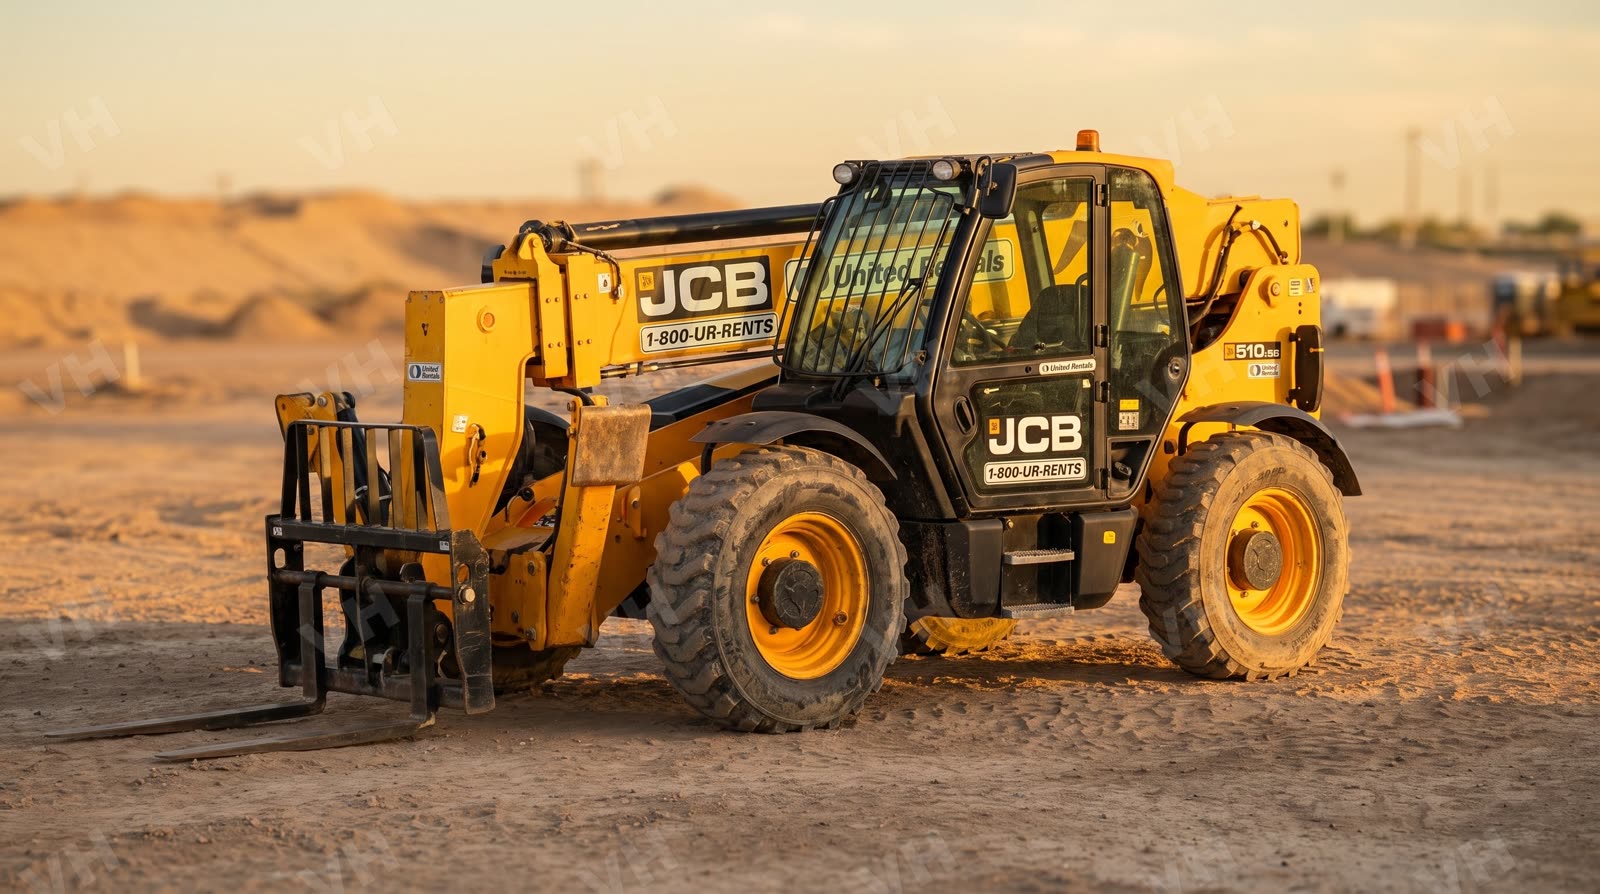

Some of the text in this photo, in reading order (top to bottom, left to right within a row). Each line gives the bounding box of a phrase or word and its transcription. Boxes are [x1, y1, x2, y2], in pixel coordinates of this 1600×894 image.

[834, 258, 912, 288] United
[640, 262, 768, 316] JCB
[646, 319, 773, 347] 1-800-UR-RENTS
[1050, 361, 1093, 372] United Rentals
[988, 415, 1082, 454] JCB
[988, 462, 1082, 479] 1-800-UR-RENTS
